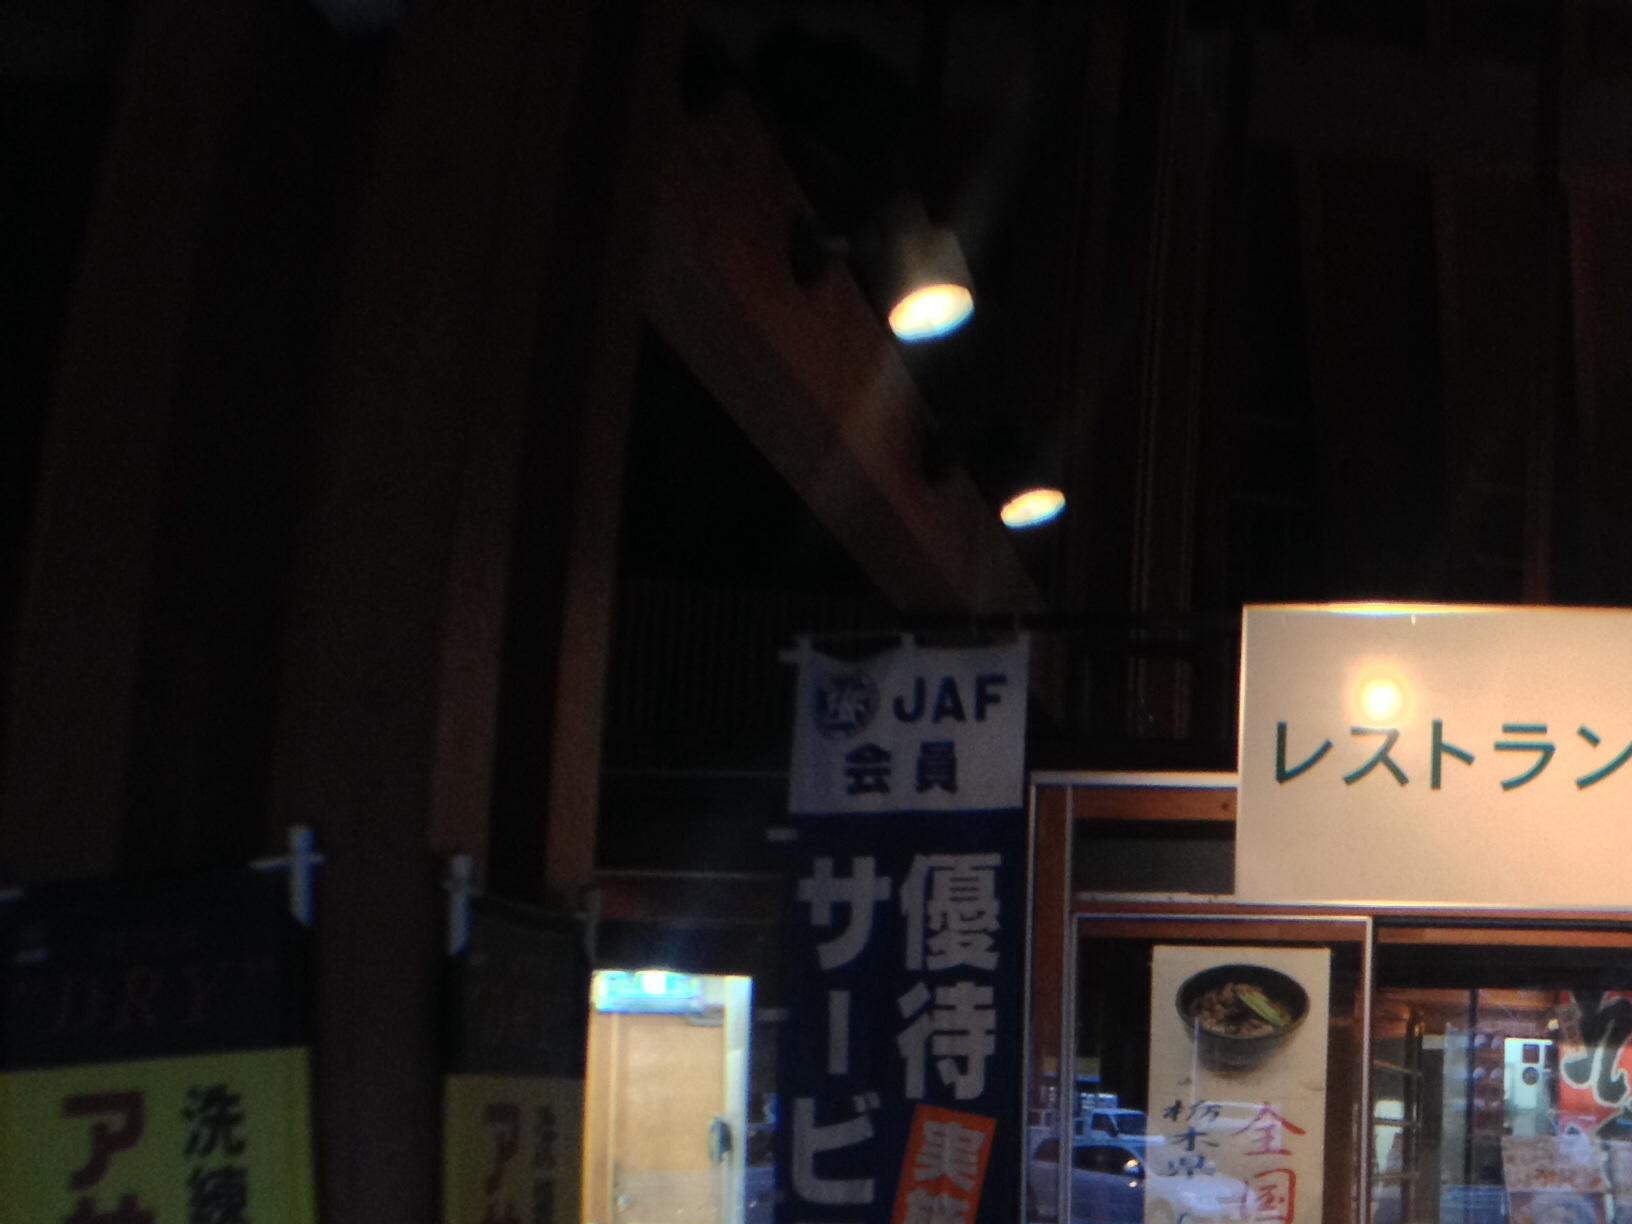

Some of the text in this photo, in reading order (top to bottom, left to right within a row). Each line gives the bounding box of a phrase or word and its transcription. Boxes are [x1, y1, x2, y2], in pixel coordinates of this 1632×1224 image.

[893, 673, 1008, 723] JAF
[845, 741, 958, 795] 会員
[897, 852, 1002, 1101] 優待
